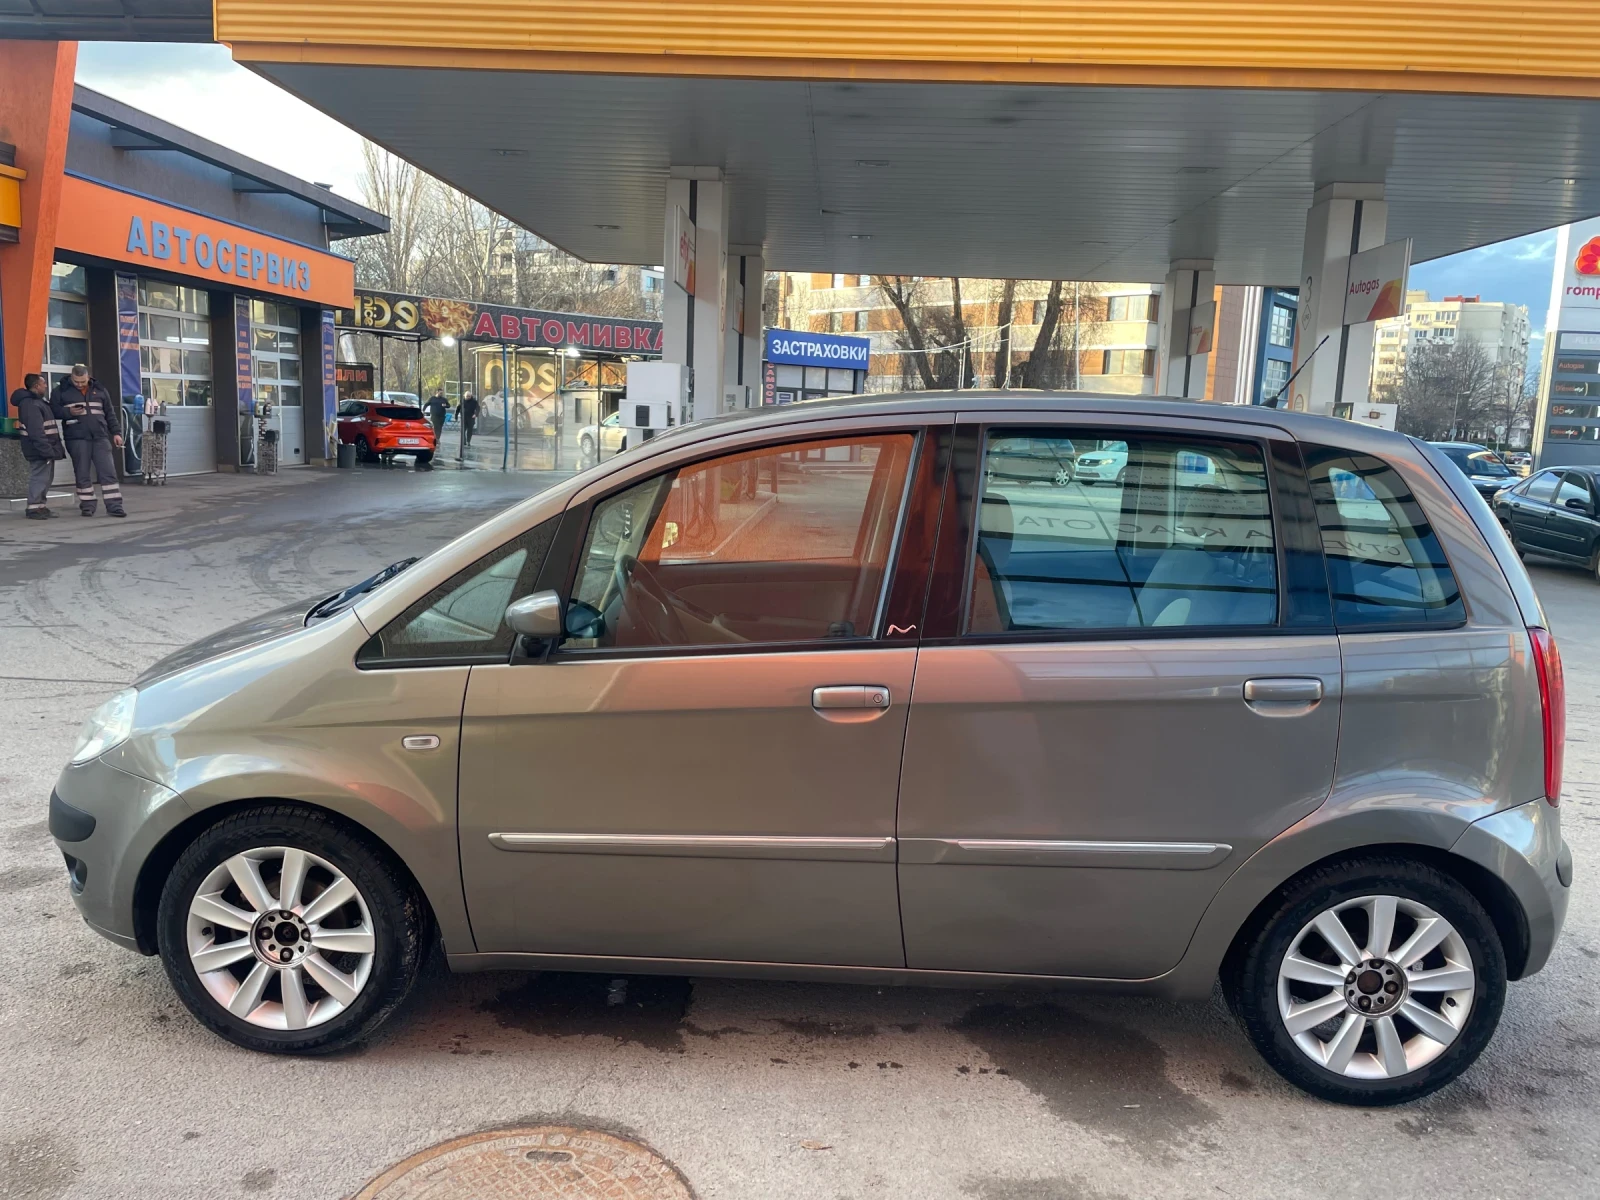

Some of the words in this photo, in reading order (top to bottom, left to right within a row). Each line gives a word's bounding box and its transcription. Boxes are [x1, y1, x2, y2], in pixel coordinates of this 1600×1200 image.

[126, 216, 311, 292] АВТОСЕРВИЗ
[1305, 275, 1313, 303] 3
[1349, 278, 1380, 296] Autogas
[772, 339, 867, 361] ЗАСТРАХОВКИ
[1558, 361, 1585, 371] Autogas
[1552, 405, 1565, 414] 95
